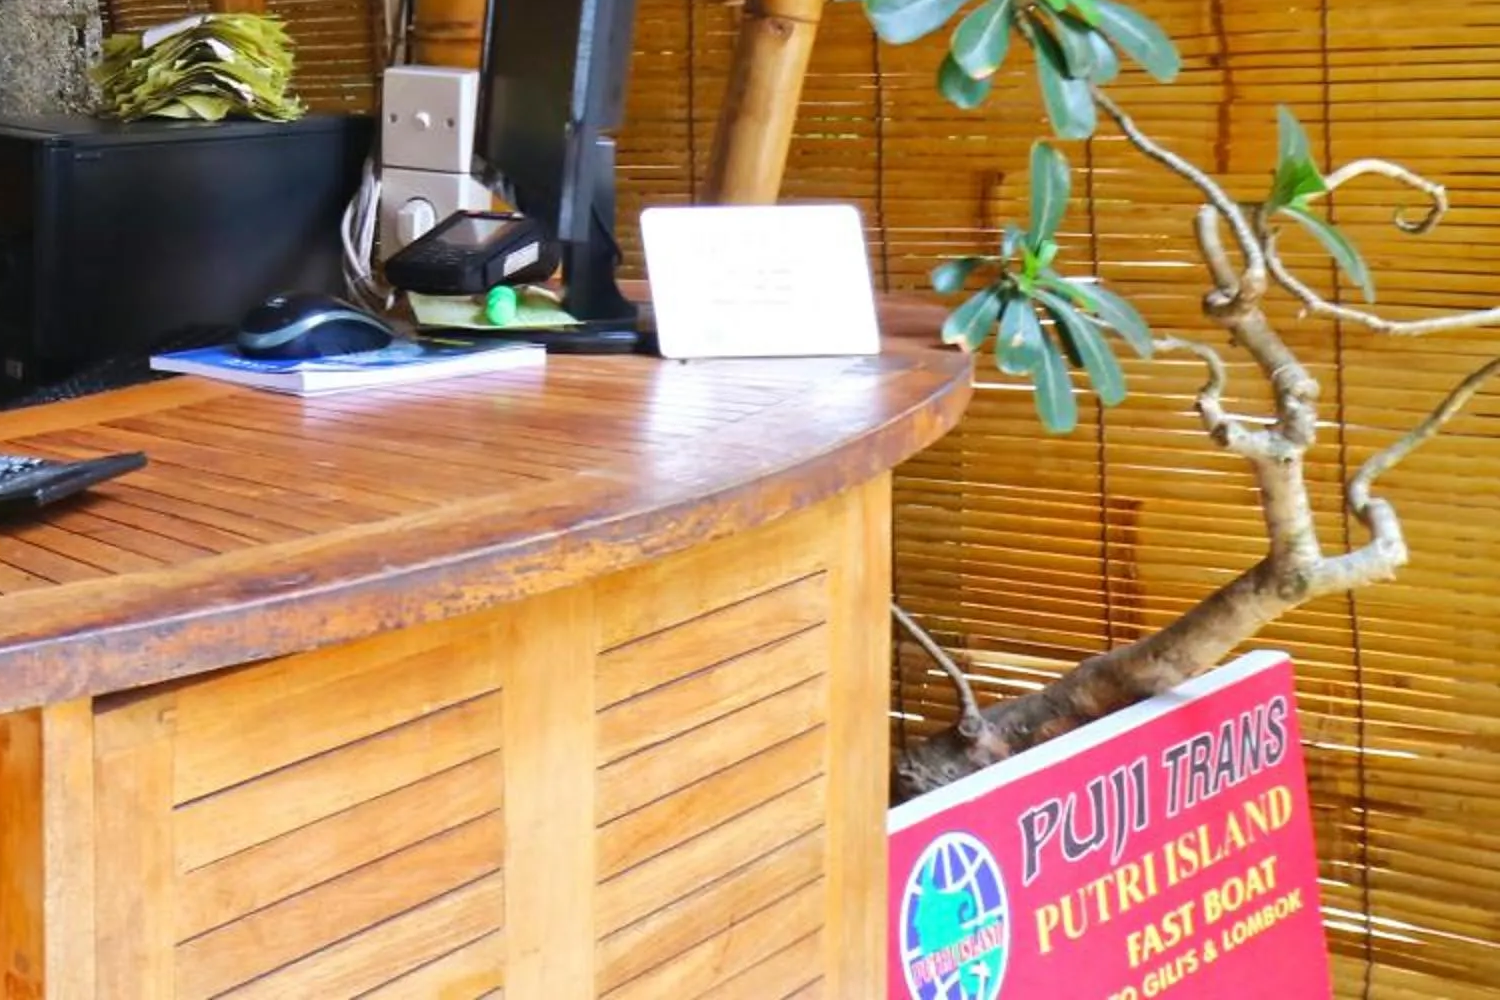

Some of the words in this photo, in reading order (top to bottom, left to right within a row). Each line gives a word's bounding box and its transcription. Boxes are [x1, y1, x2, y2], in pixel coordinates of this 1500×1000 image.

[1019, 755, 1149, 888] PUJI
[1161, 696, 1288, 818] TRANS
[1035, 852, 1160, 954] PUTRI
[1163, 785, 1293, 887] ISLAND
[1126, 900, 1195, 969] FAST
[1202, 856, 1278, 925] BOAT
[1202, 938, 1219, 963] &
[1221, 887, 1304, 952] LOMBOK
